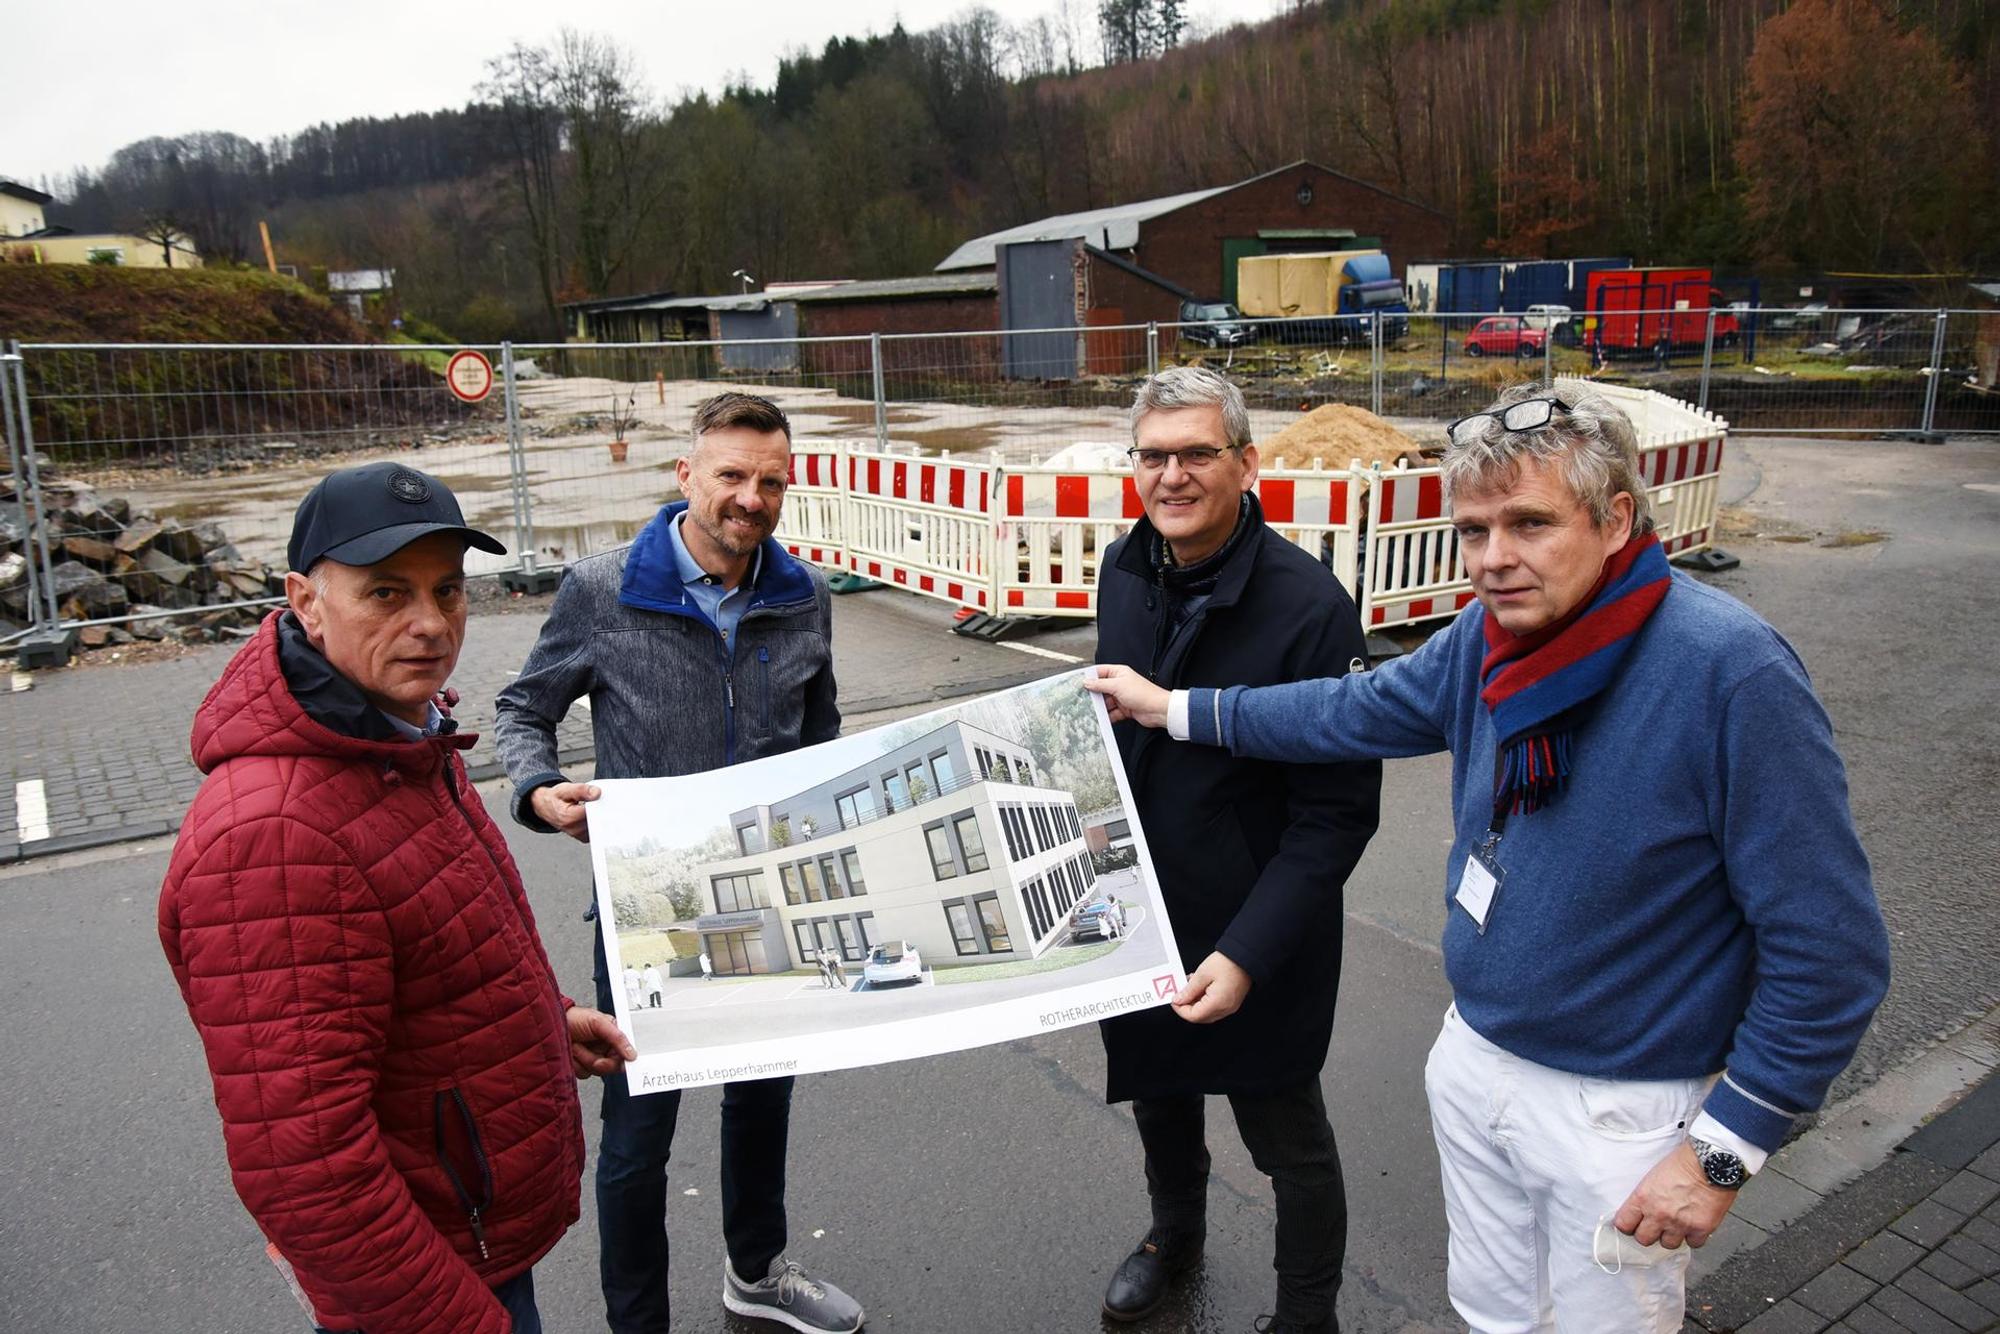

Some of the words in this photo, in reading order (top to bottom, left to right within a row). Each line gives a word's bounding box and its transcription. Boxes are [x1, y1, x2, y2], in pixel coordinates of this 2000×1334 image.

[1039, 991, 1153, 1027] ROTHERARCHITEKTUR
[642, 1071, 704, 1088] Ärztehaus
[706, 1059, 798, 1081] Lepperhammer
